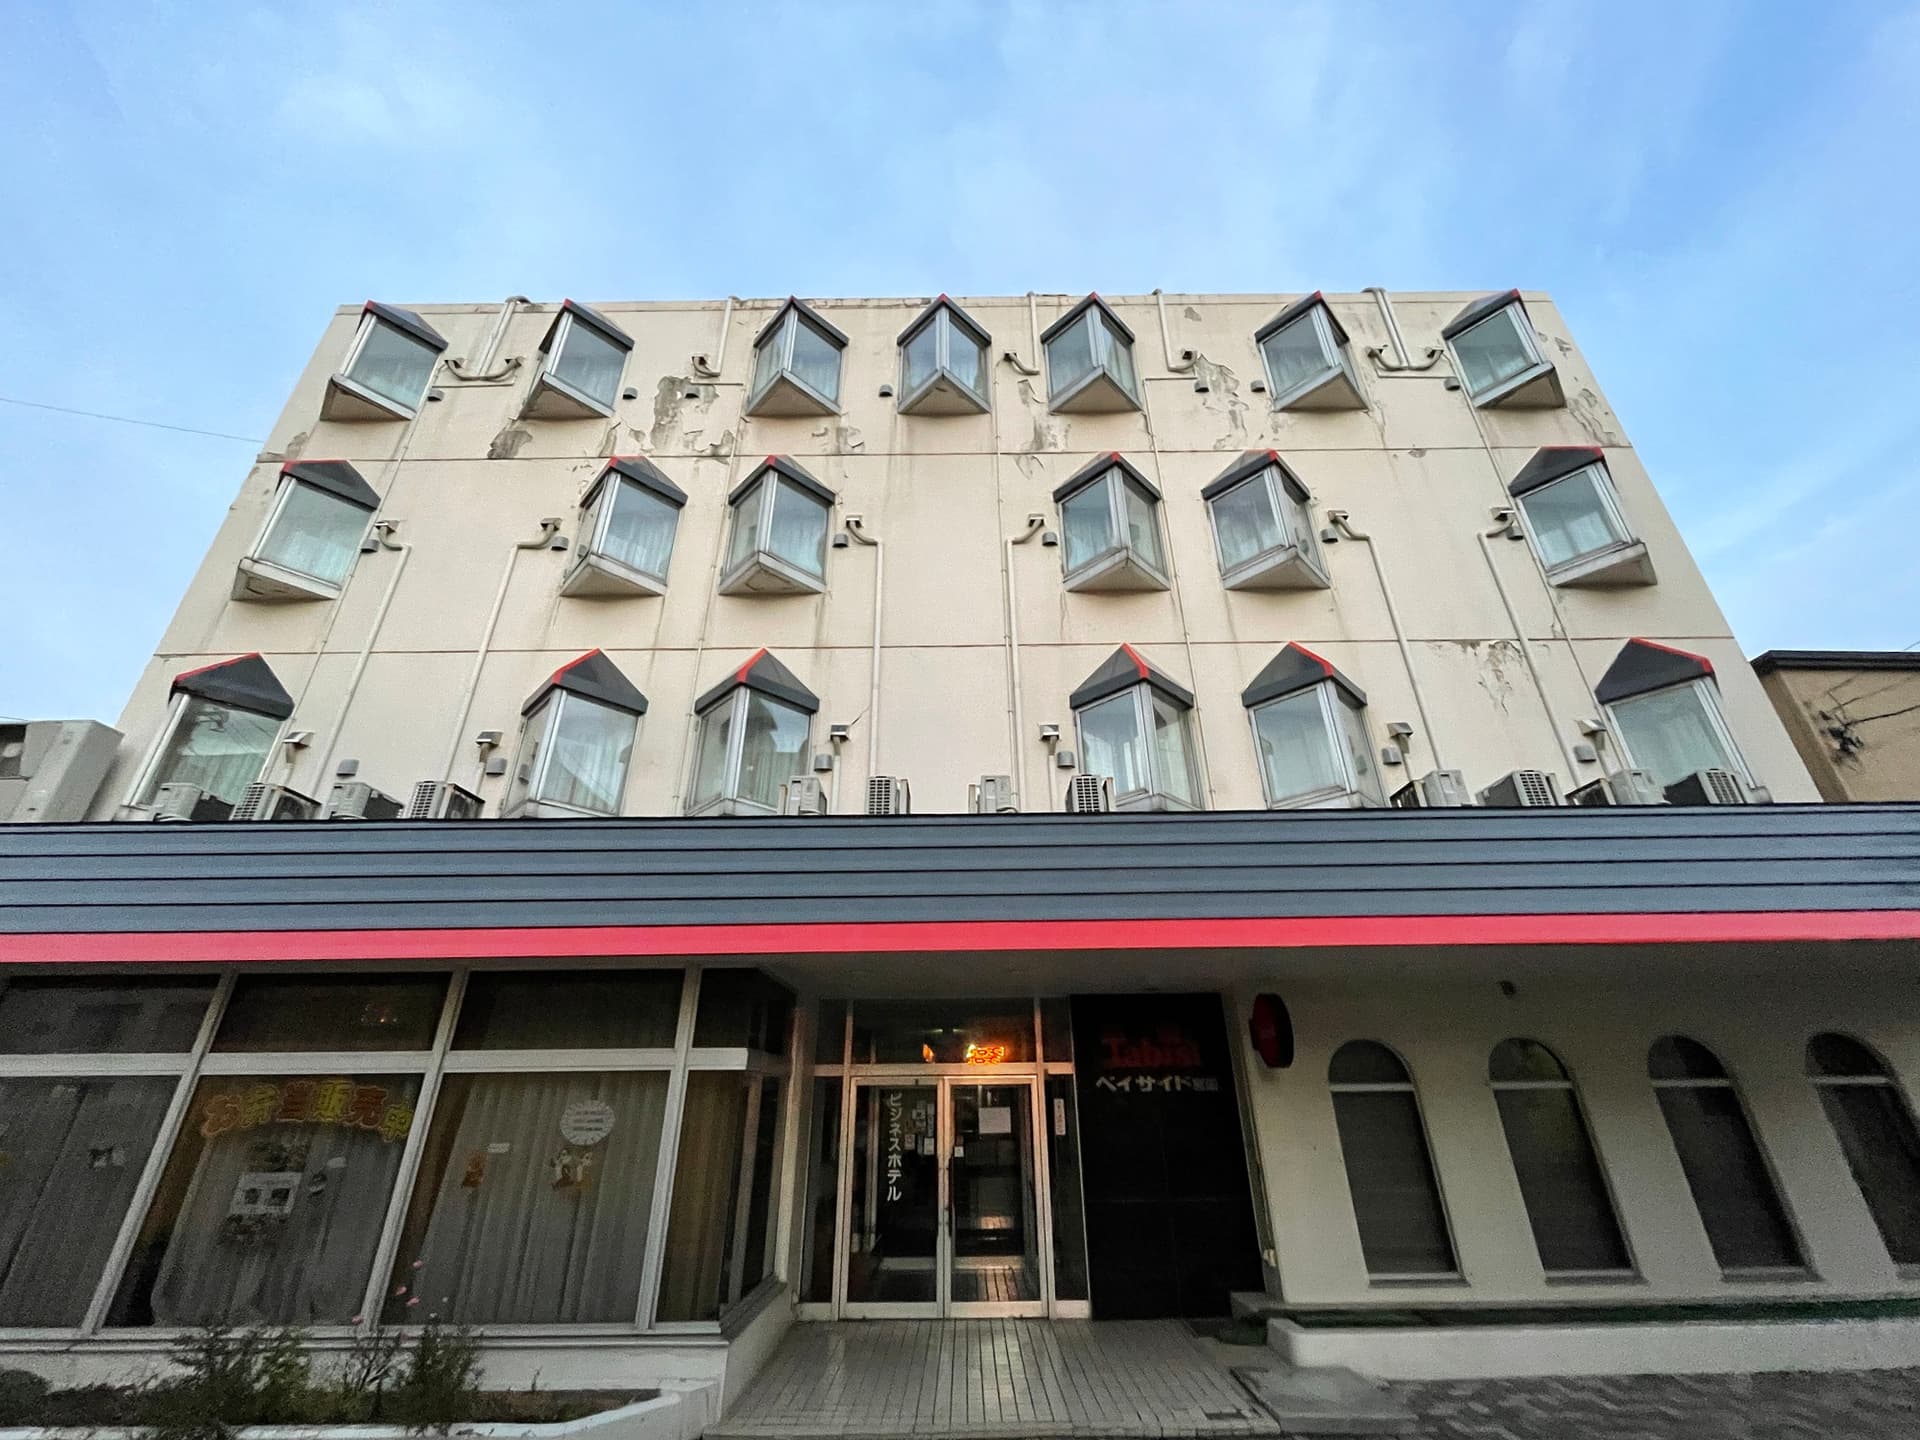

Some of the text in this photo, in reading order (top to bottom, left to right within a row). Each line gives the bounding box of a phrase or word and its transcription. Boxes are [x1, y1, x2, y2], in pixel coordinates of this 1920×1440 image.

[201, 1079, 415, 1143] お弁当販売中
